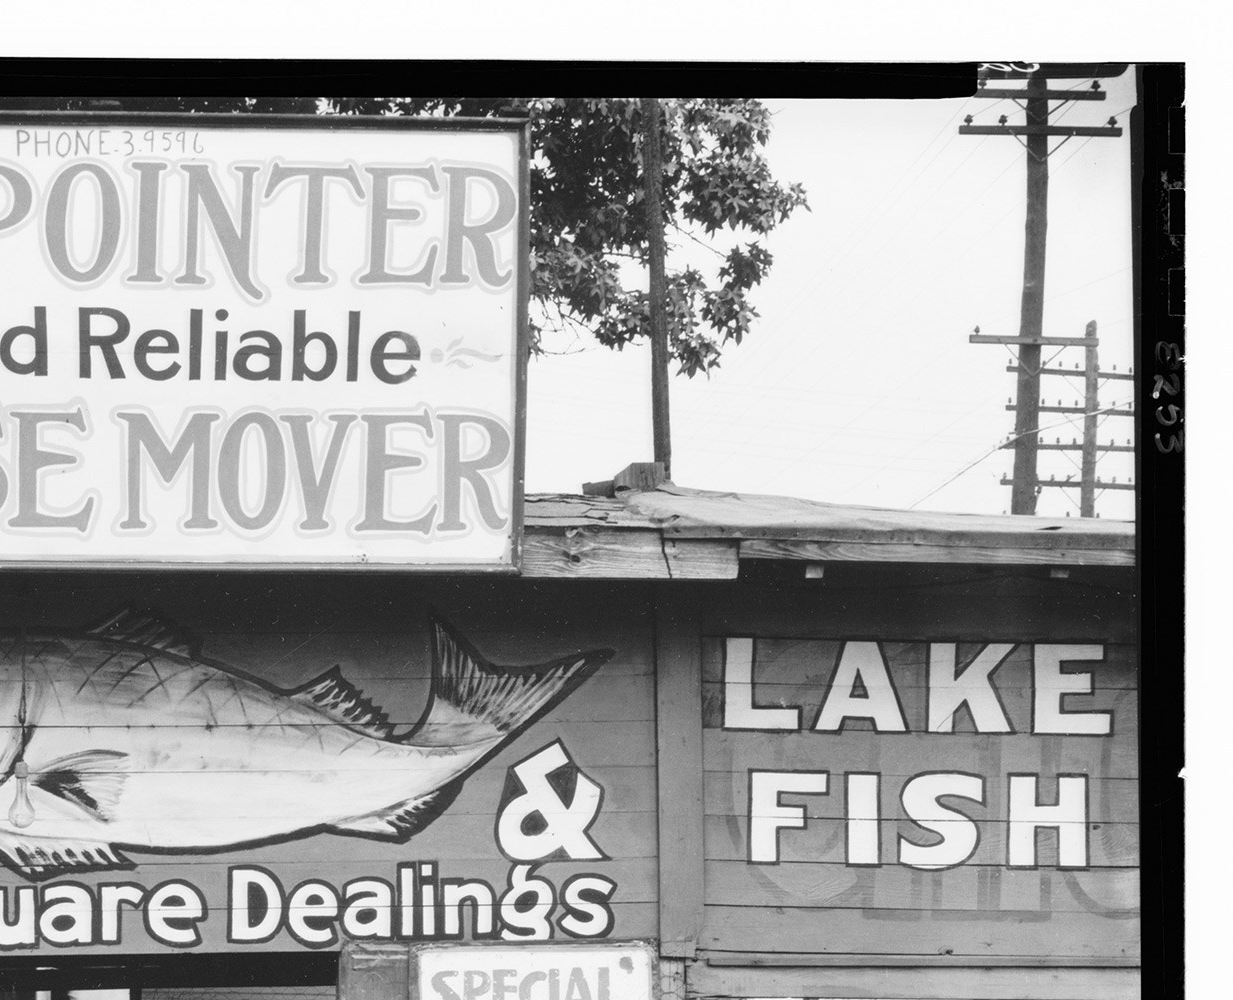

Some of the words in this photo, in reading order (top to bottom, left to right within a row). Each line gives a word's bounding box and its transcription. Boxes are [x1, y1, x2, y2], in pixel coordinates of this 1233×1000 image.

[78, 306, 422, 386] Reliable
[117, 403, 513, 541] MOVER
[722, 635, 1114, 737] LAKE
[495, 738, 610, 862] &
[747, 769, 1090, 871] FISH
[227, 860, 617, 945] Dealings
